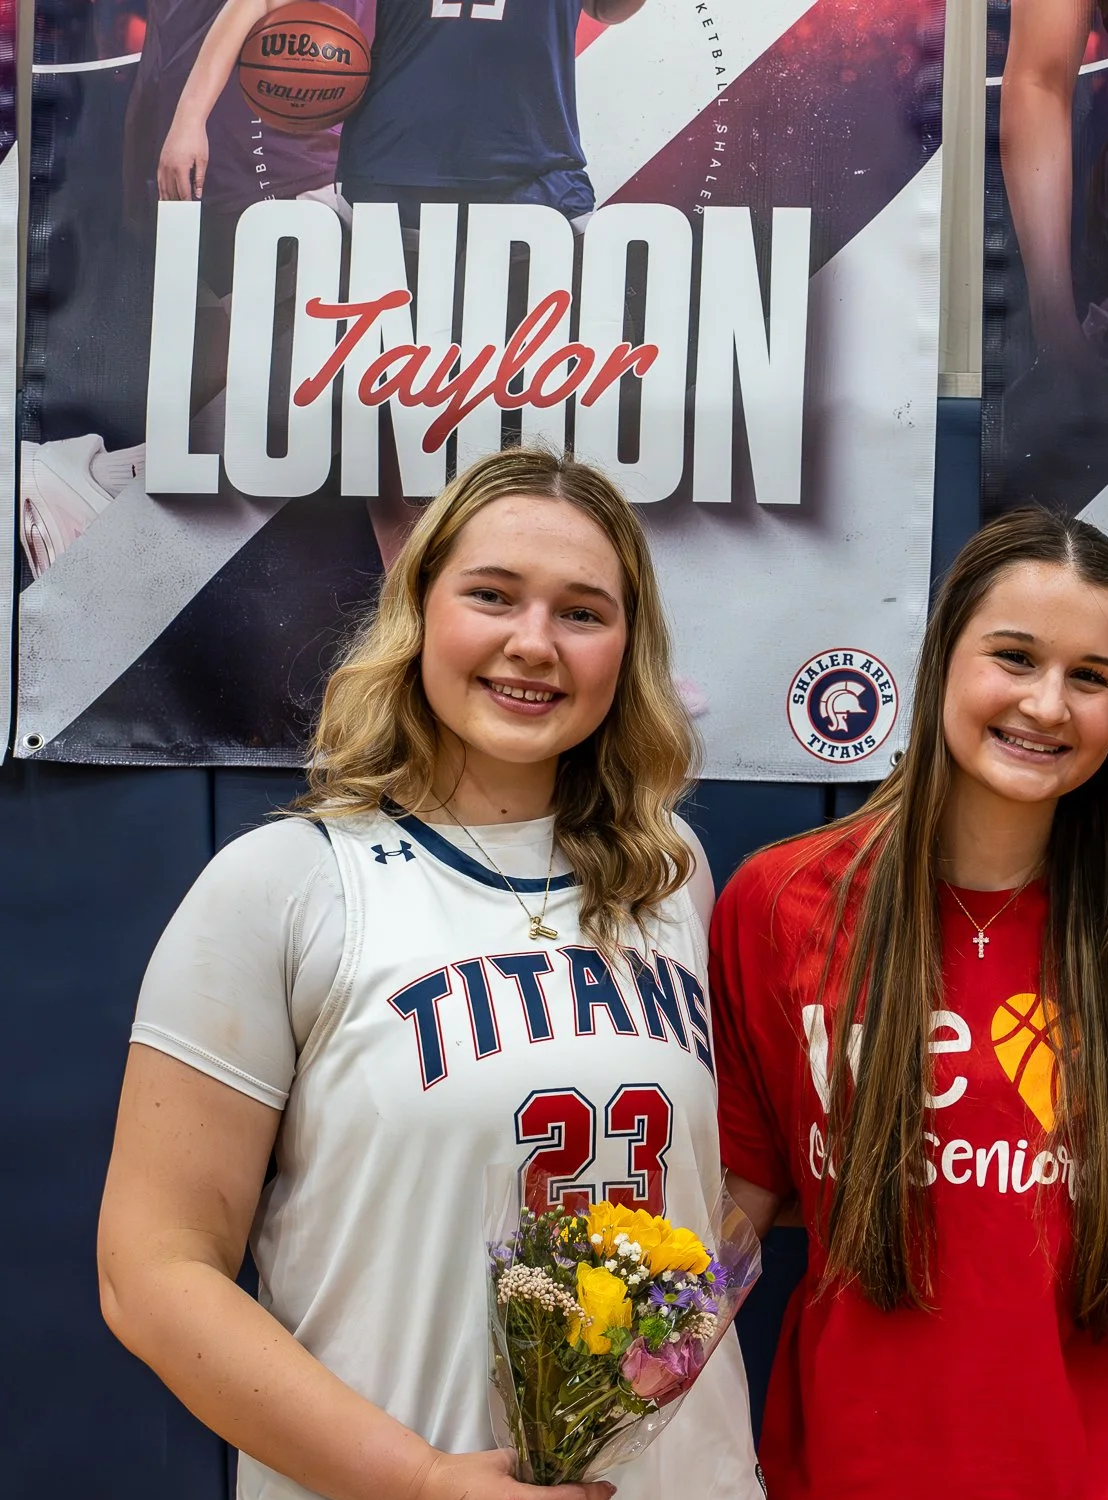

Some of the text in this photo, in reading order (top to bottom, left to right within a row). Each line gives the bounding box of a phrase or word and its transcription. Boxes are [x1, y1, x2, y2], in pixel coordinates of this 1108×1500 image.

[261, 34, 352, 66] Wilson
[256, 79, 346, 101] EVOLUTION
[692, 125, 728, 215] SHALER
[145, 200, 812, 505] LONDON
[293, 288, 660, 455] Taylor
[793, 653, 894, 706] SHALER AREA
[807, 733, 876, 759] TITANS
[513, 1082, 674, 1224] 23
